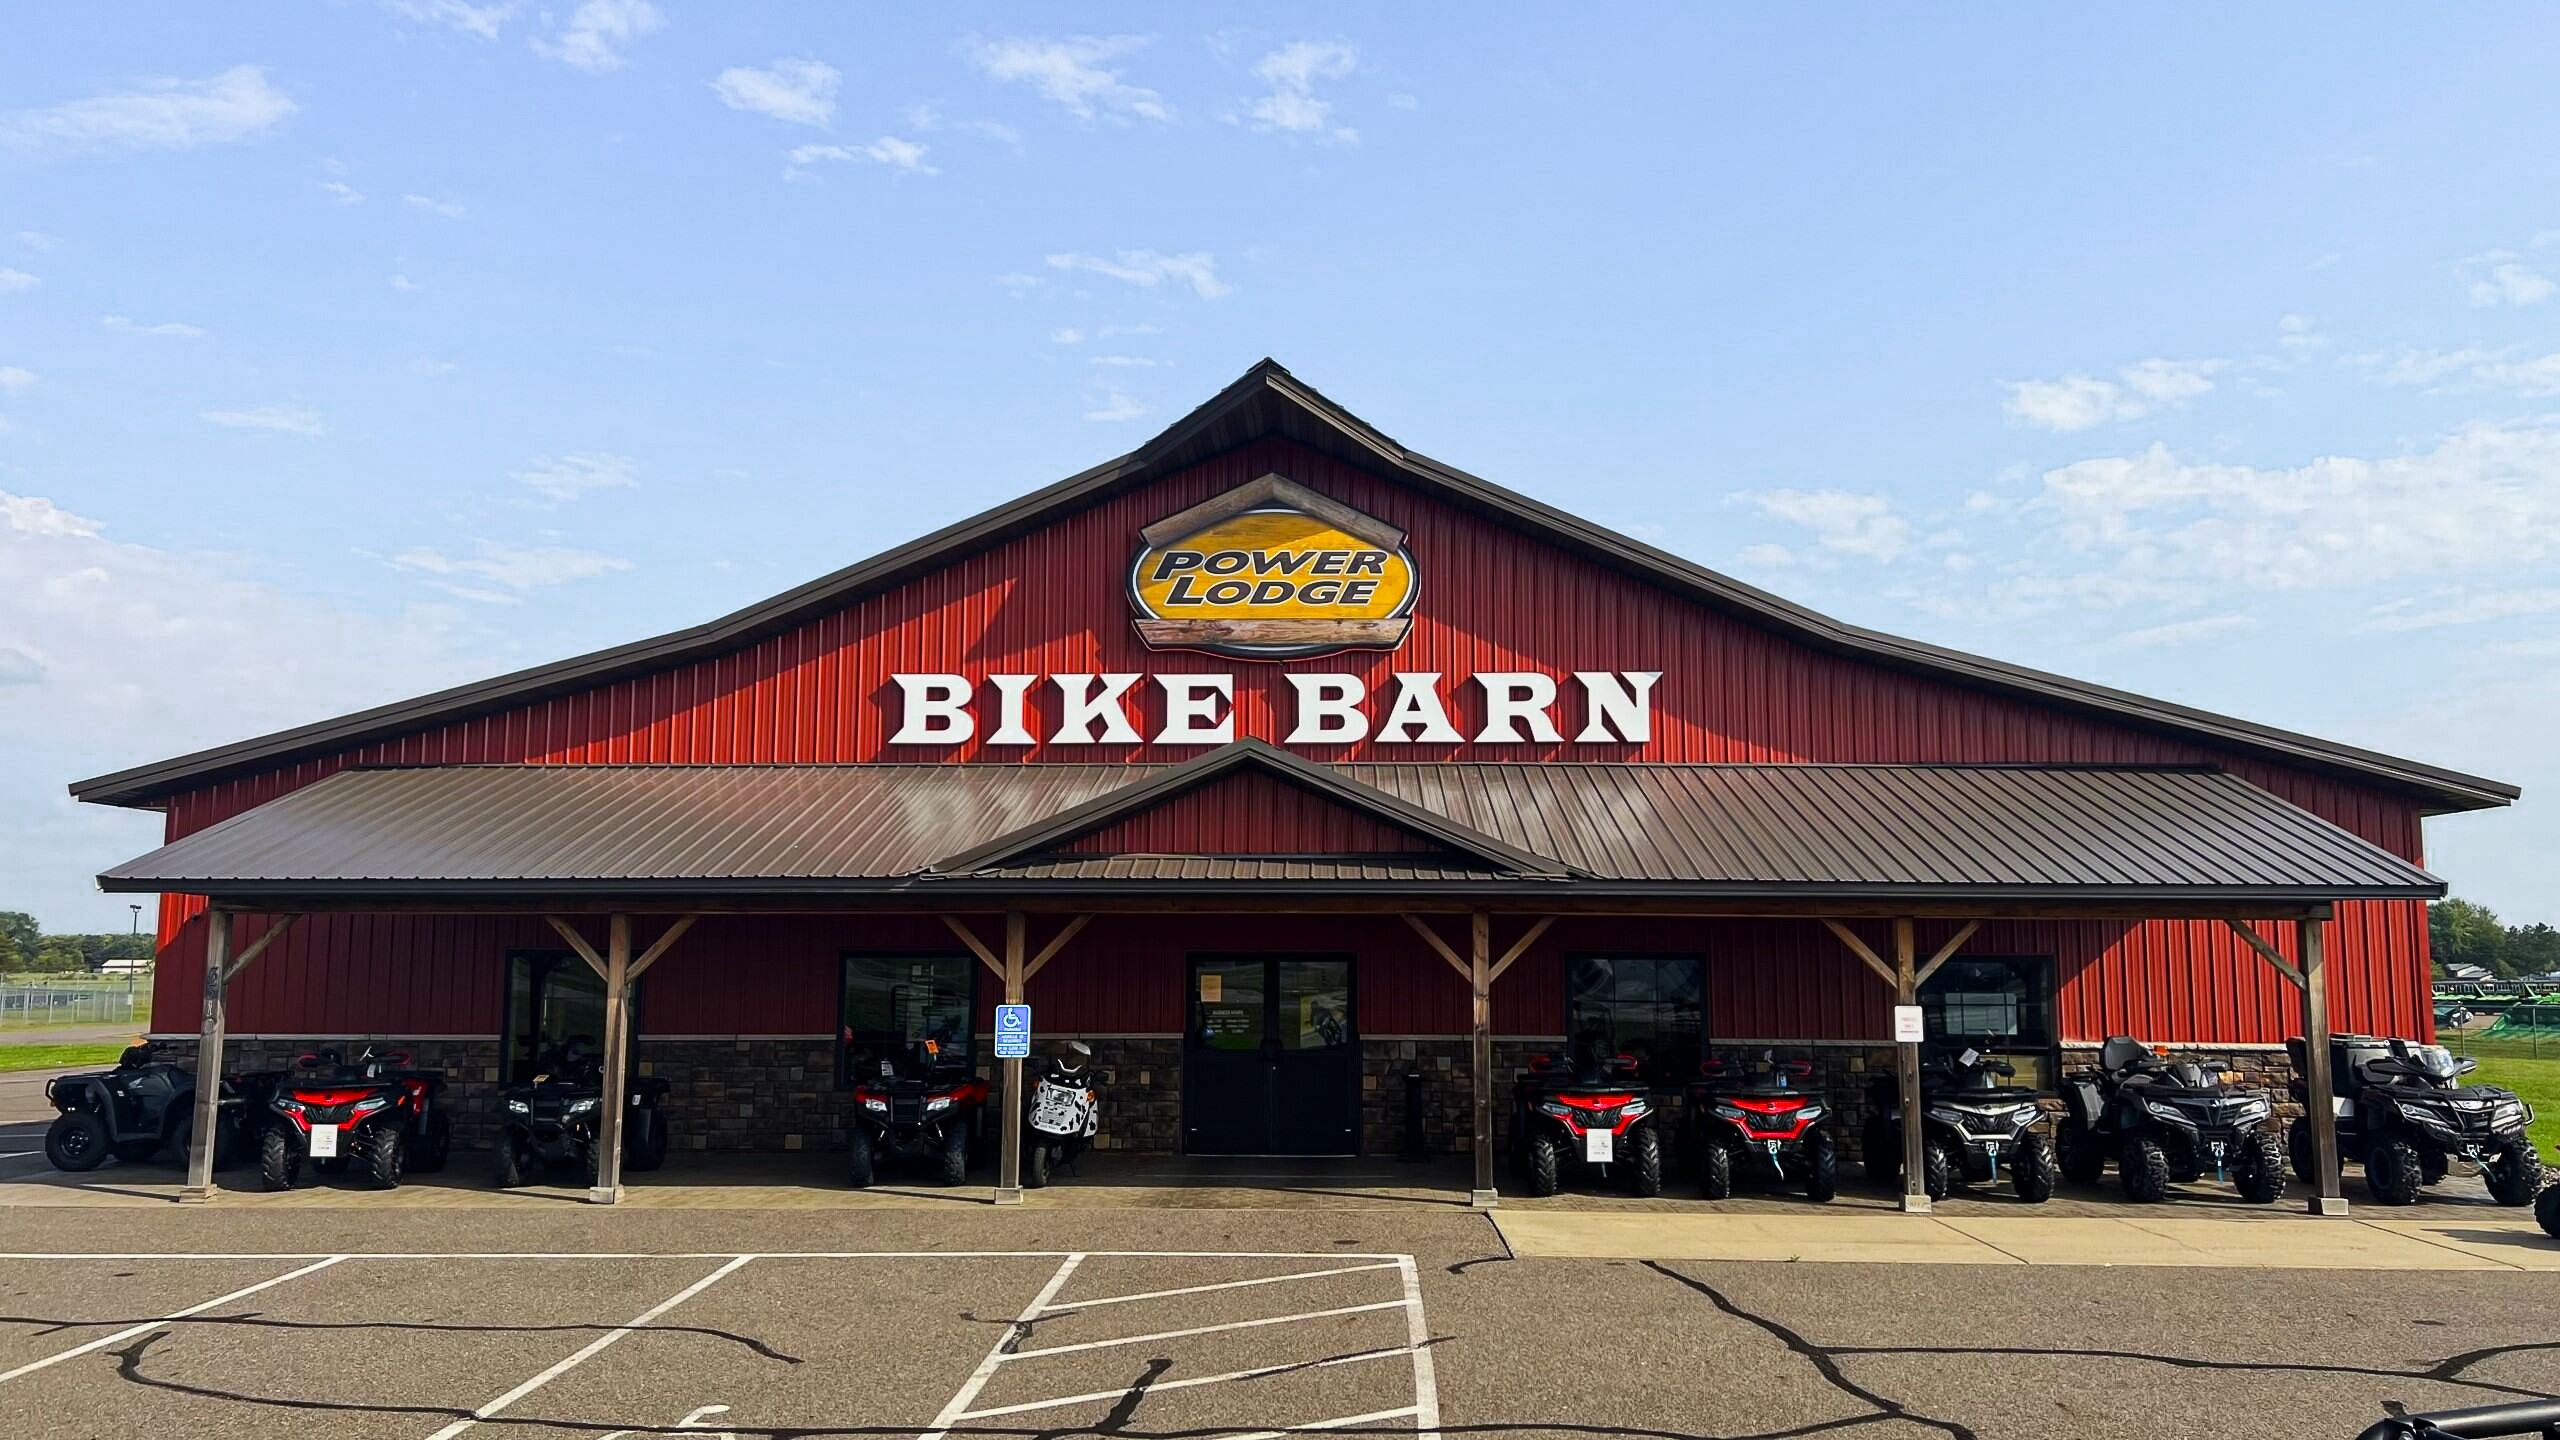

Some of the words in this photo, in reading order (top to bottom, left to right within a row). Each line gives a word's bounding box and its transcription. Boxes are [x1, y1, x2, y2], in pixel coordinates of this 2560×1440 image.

[1153, 550, 1389, 581] POWER
[1164, 576, 1381, 607] LODGE
[887, 673, 1234, 744] BIKE
[1283, 671, 1664, 744] BARN
